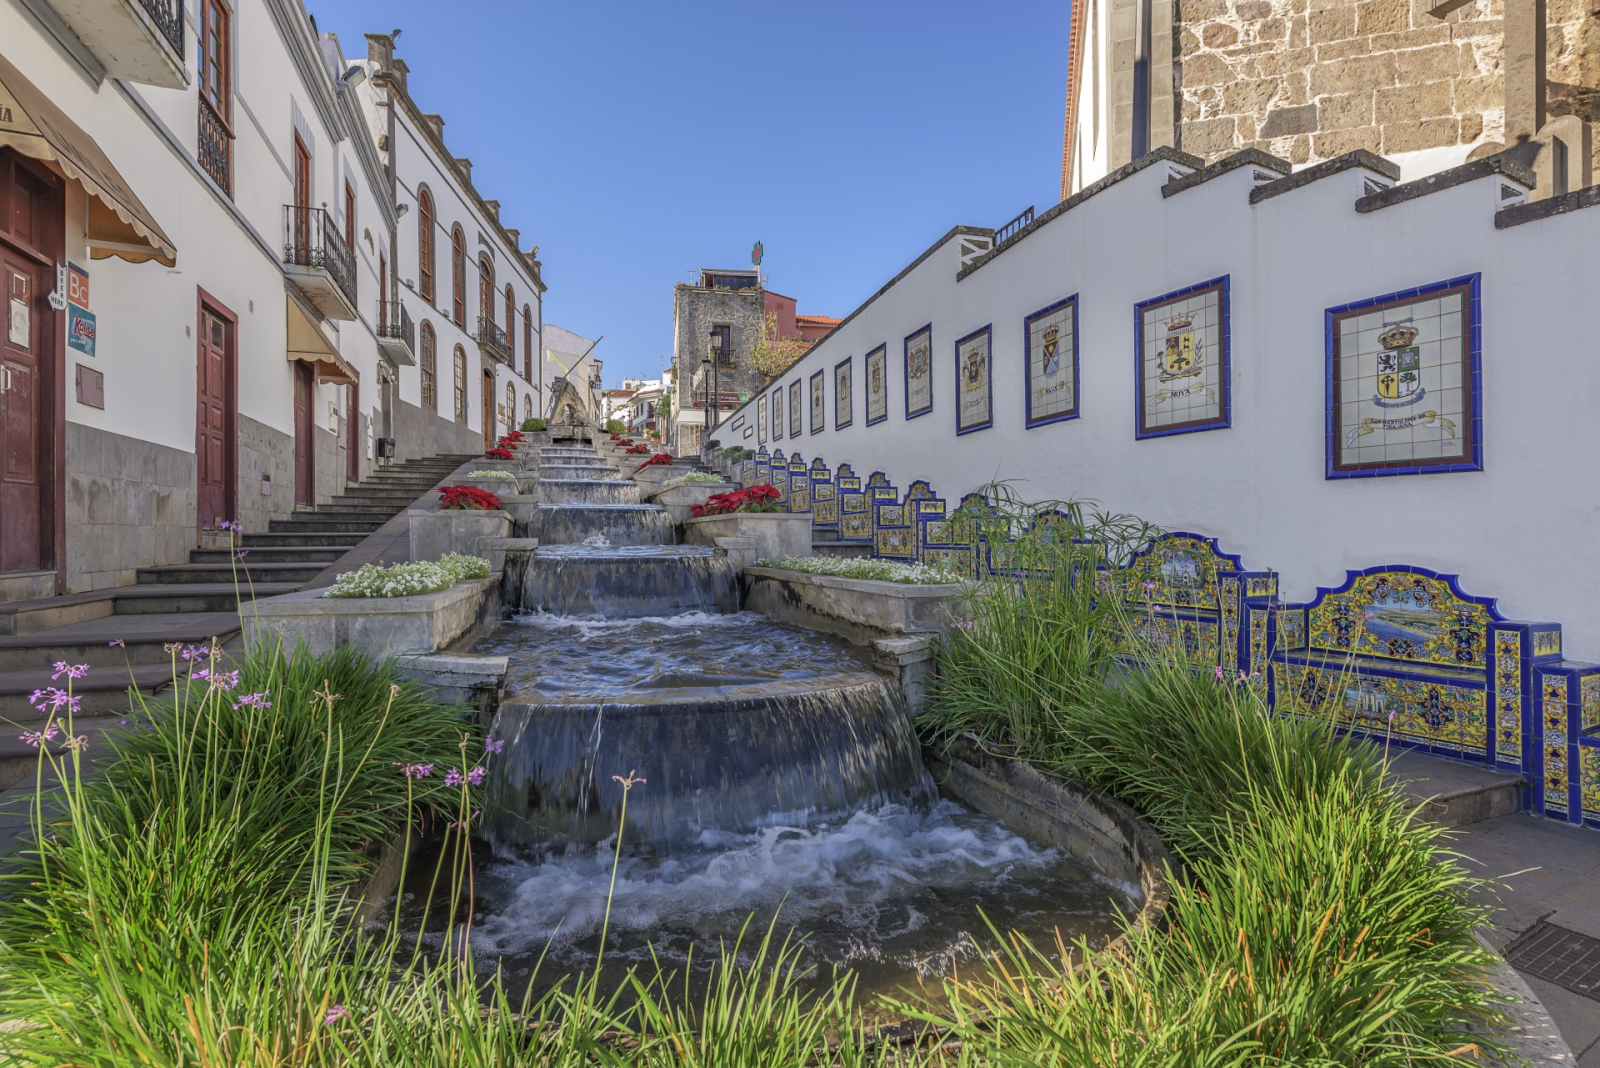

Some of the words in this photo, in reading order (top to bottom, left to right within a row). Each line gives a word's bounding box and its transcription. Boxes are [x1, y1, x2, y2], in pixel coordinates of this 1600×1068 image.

[69, 272, 88, 303] Bc
[50, 295, 64, 307] HERE
[73, 313, 94, 337] Kalise
[1170, 389, 1191, 397] MOYA
